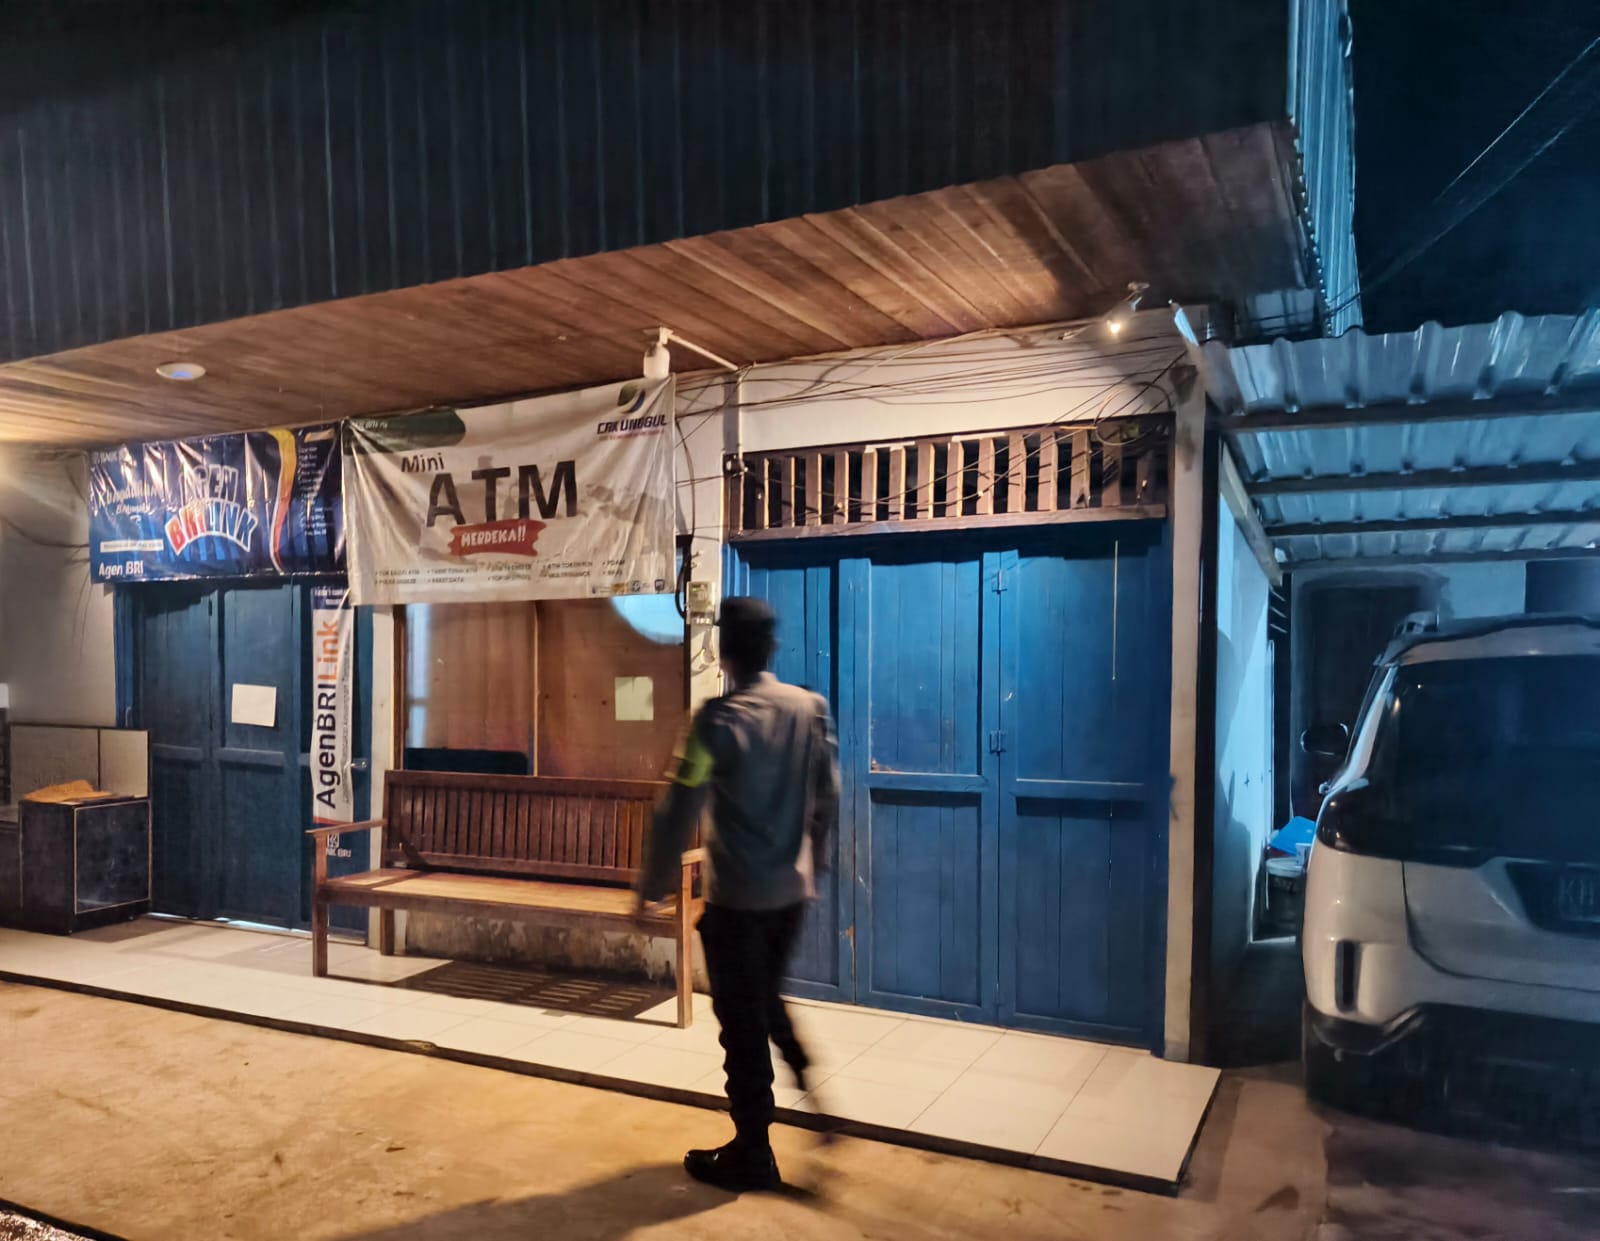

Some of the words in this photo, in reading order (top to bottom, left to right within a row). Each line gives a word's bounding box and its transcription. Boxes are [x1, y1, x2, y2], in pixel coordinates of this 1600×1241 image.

[401, 453, 445, 473] Mini
[426, 460, 577, 527] ATM
[460, 525, 527, 547] MERDEKA!!
[99, 562, 123, 579] Agen
[126, 560, 143, 575] BRI
[316, 620, 340, 808] AgenBRILink
